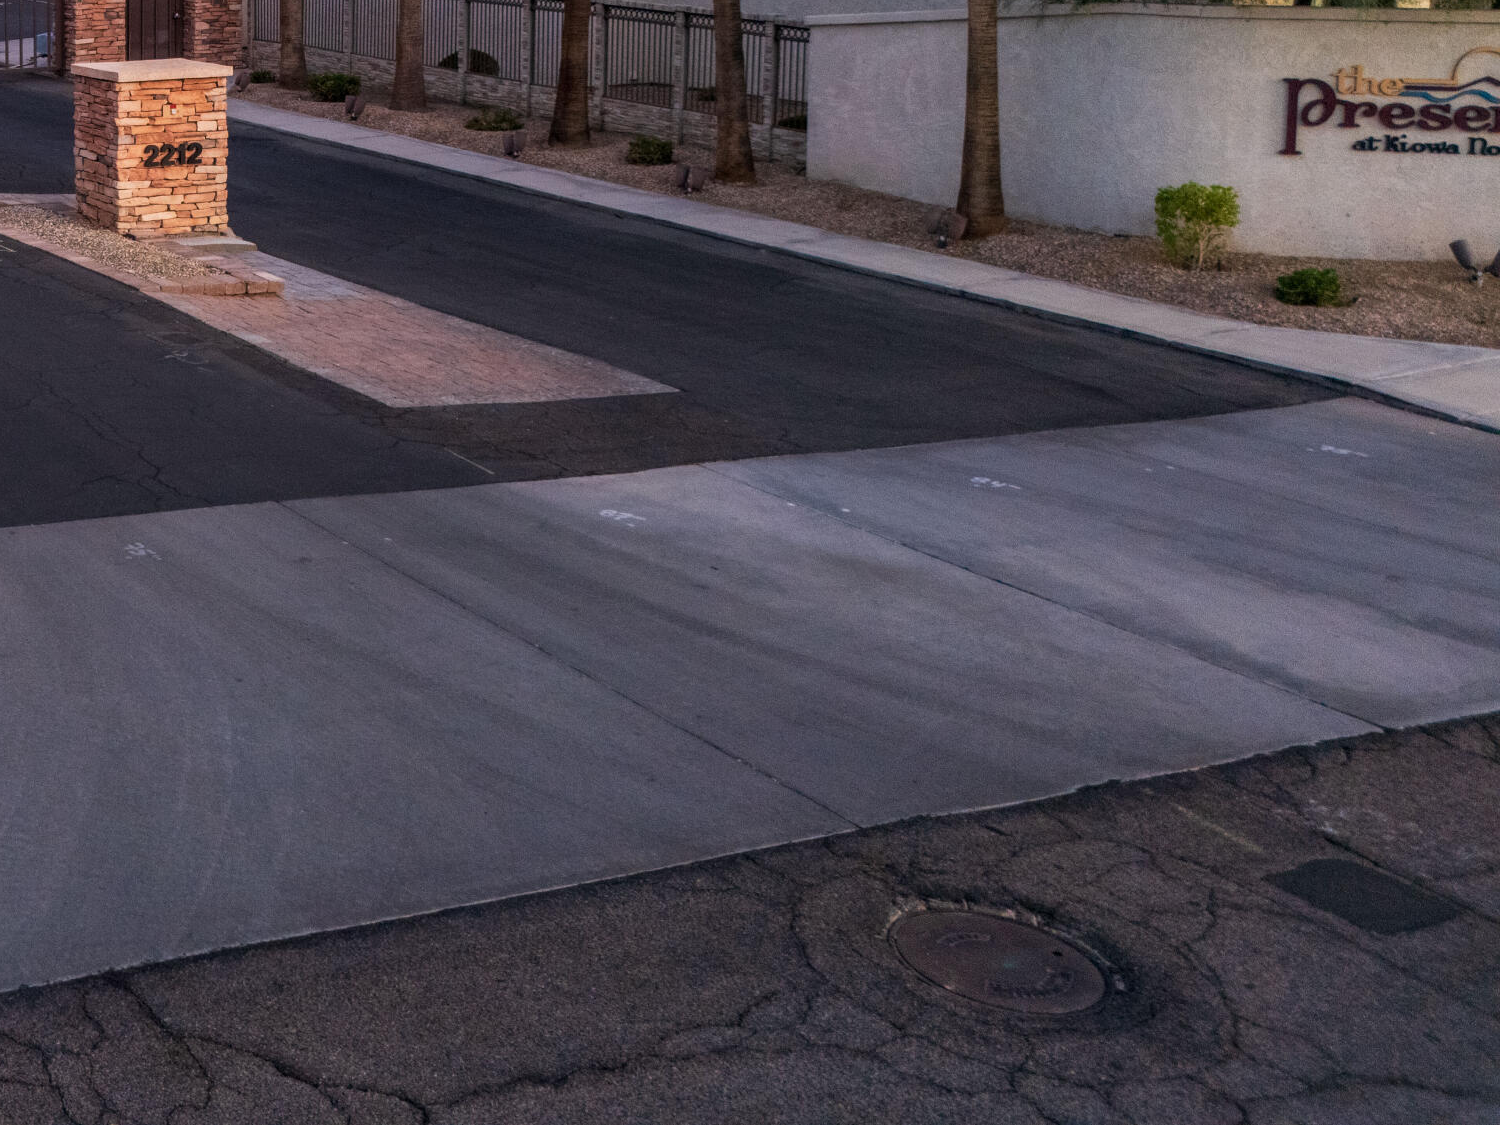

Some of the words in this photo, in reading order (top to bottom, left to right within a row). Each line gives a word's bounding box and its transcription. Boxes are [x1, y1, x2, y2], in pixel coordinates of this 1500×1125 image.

[1330, 64, 1405, 96] the
[143, 141, 203, 168] 2212
[1352, 135, 1382, 152] at
[1384, 134, 1461, 155] Kiowa
